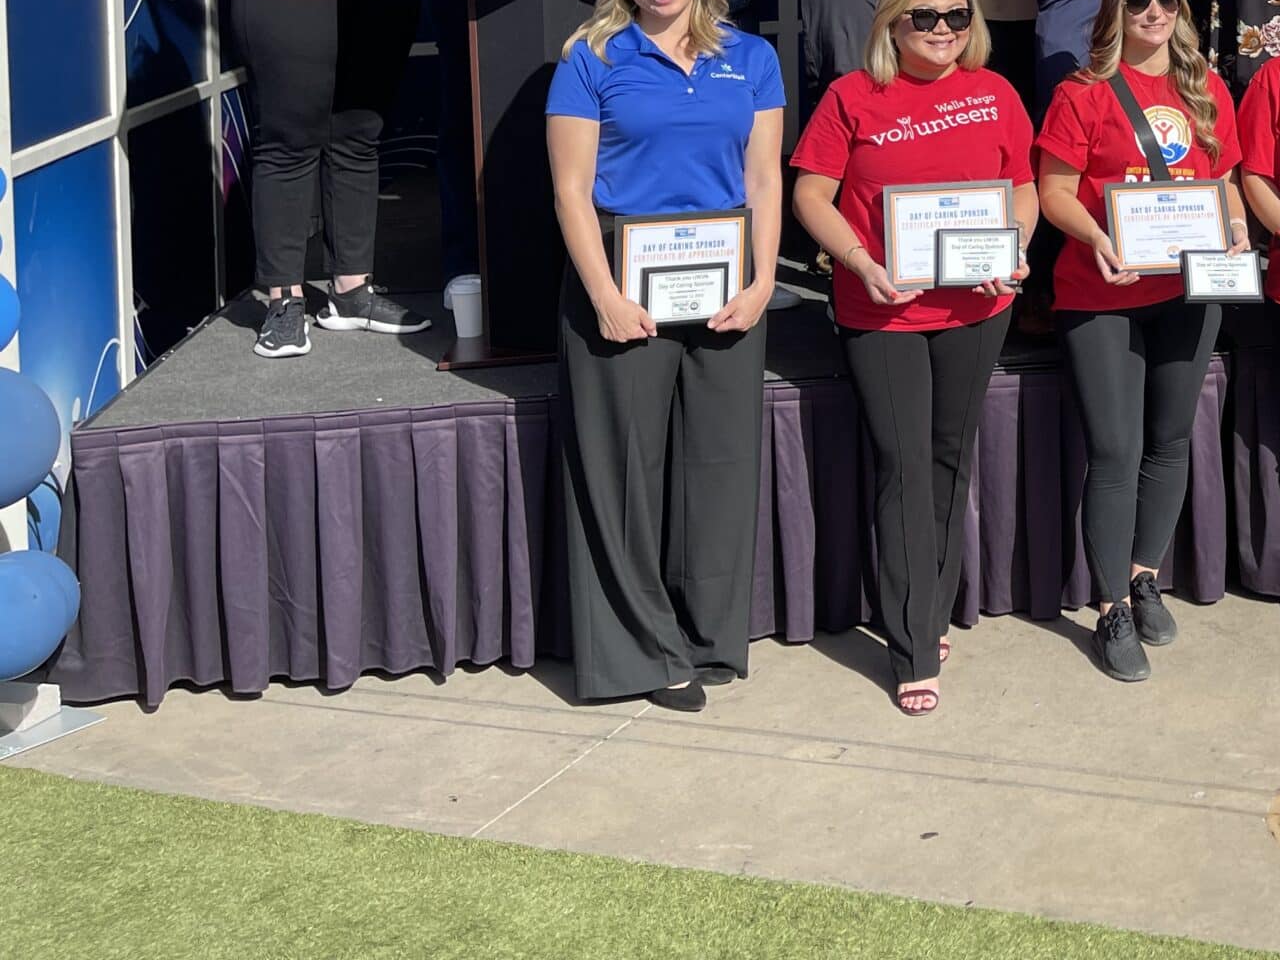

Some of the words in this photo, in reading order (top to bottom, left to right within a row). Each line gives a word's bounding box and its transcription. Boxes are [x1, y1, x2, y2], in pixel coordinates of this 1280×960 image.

[934, 100, 965, 113] Wells
[965, 95, 996, 106] Fargo
[910, 211, 922, 220] DAY
[924, 211, 932, 220] OF
[934, 210, 958, 220] CARING
[960, 208, 988, 218] SPONSOR
[1131, 206, 1143, 214] DAY
[1154, 205, 1176, 213] CARING
[1178, 204, 1204, 212] SPONSOR
[643, 244, 656, 253] DAY
[658, 242, 667, 251] OF
[668, 241, 693, 251] CARING
[696, 239, 725, 249] SPONSOR
